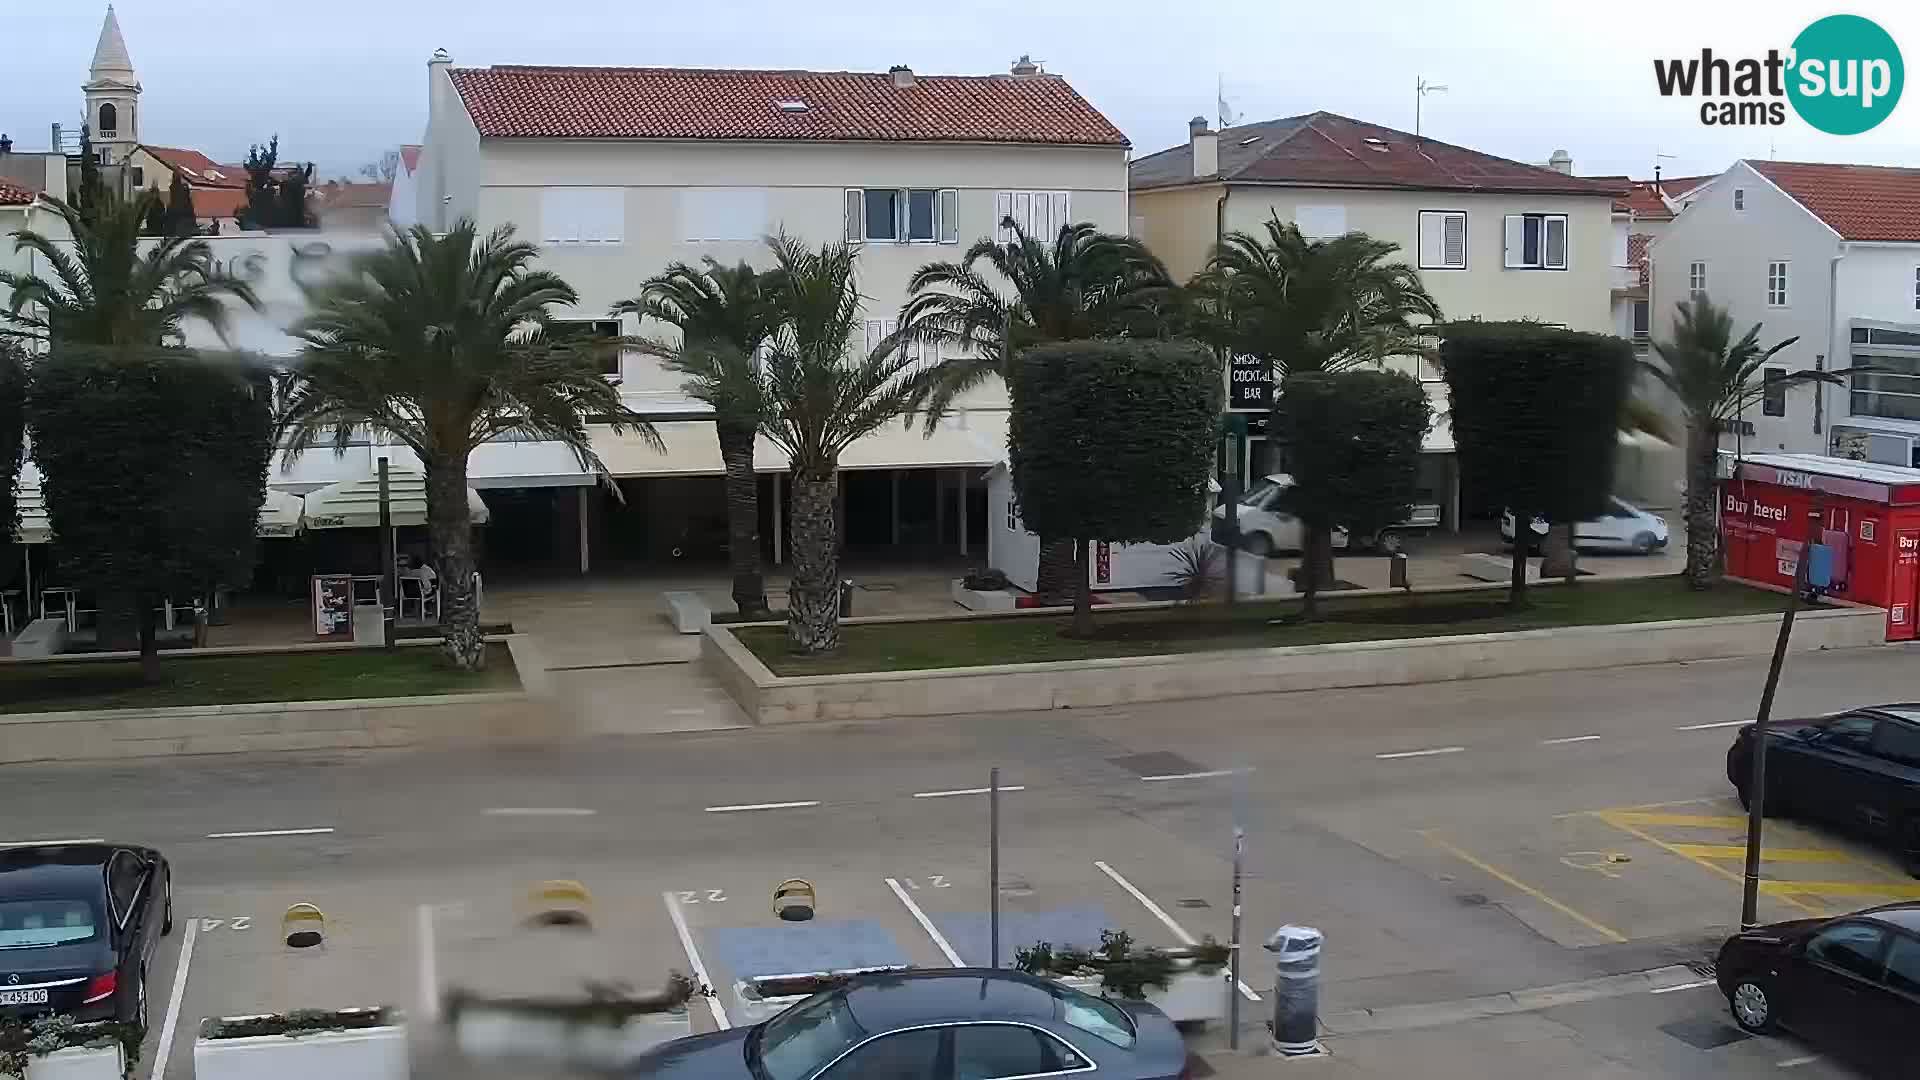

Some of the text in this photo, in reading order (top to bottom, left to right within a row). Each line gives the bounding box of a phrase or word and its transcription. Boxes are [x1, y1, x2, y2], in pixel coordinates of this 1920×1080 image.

[1244, 387, 1261, 400] BAR
[1727, 494, 1787, 520] Buy here!
[1899, 536, 1919, 550] Buy
[201, 916, 251, 932] 24
